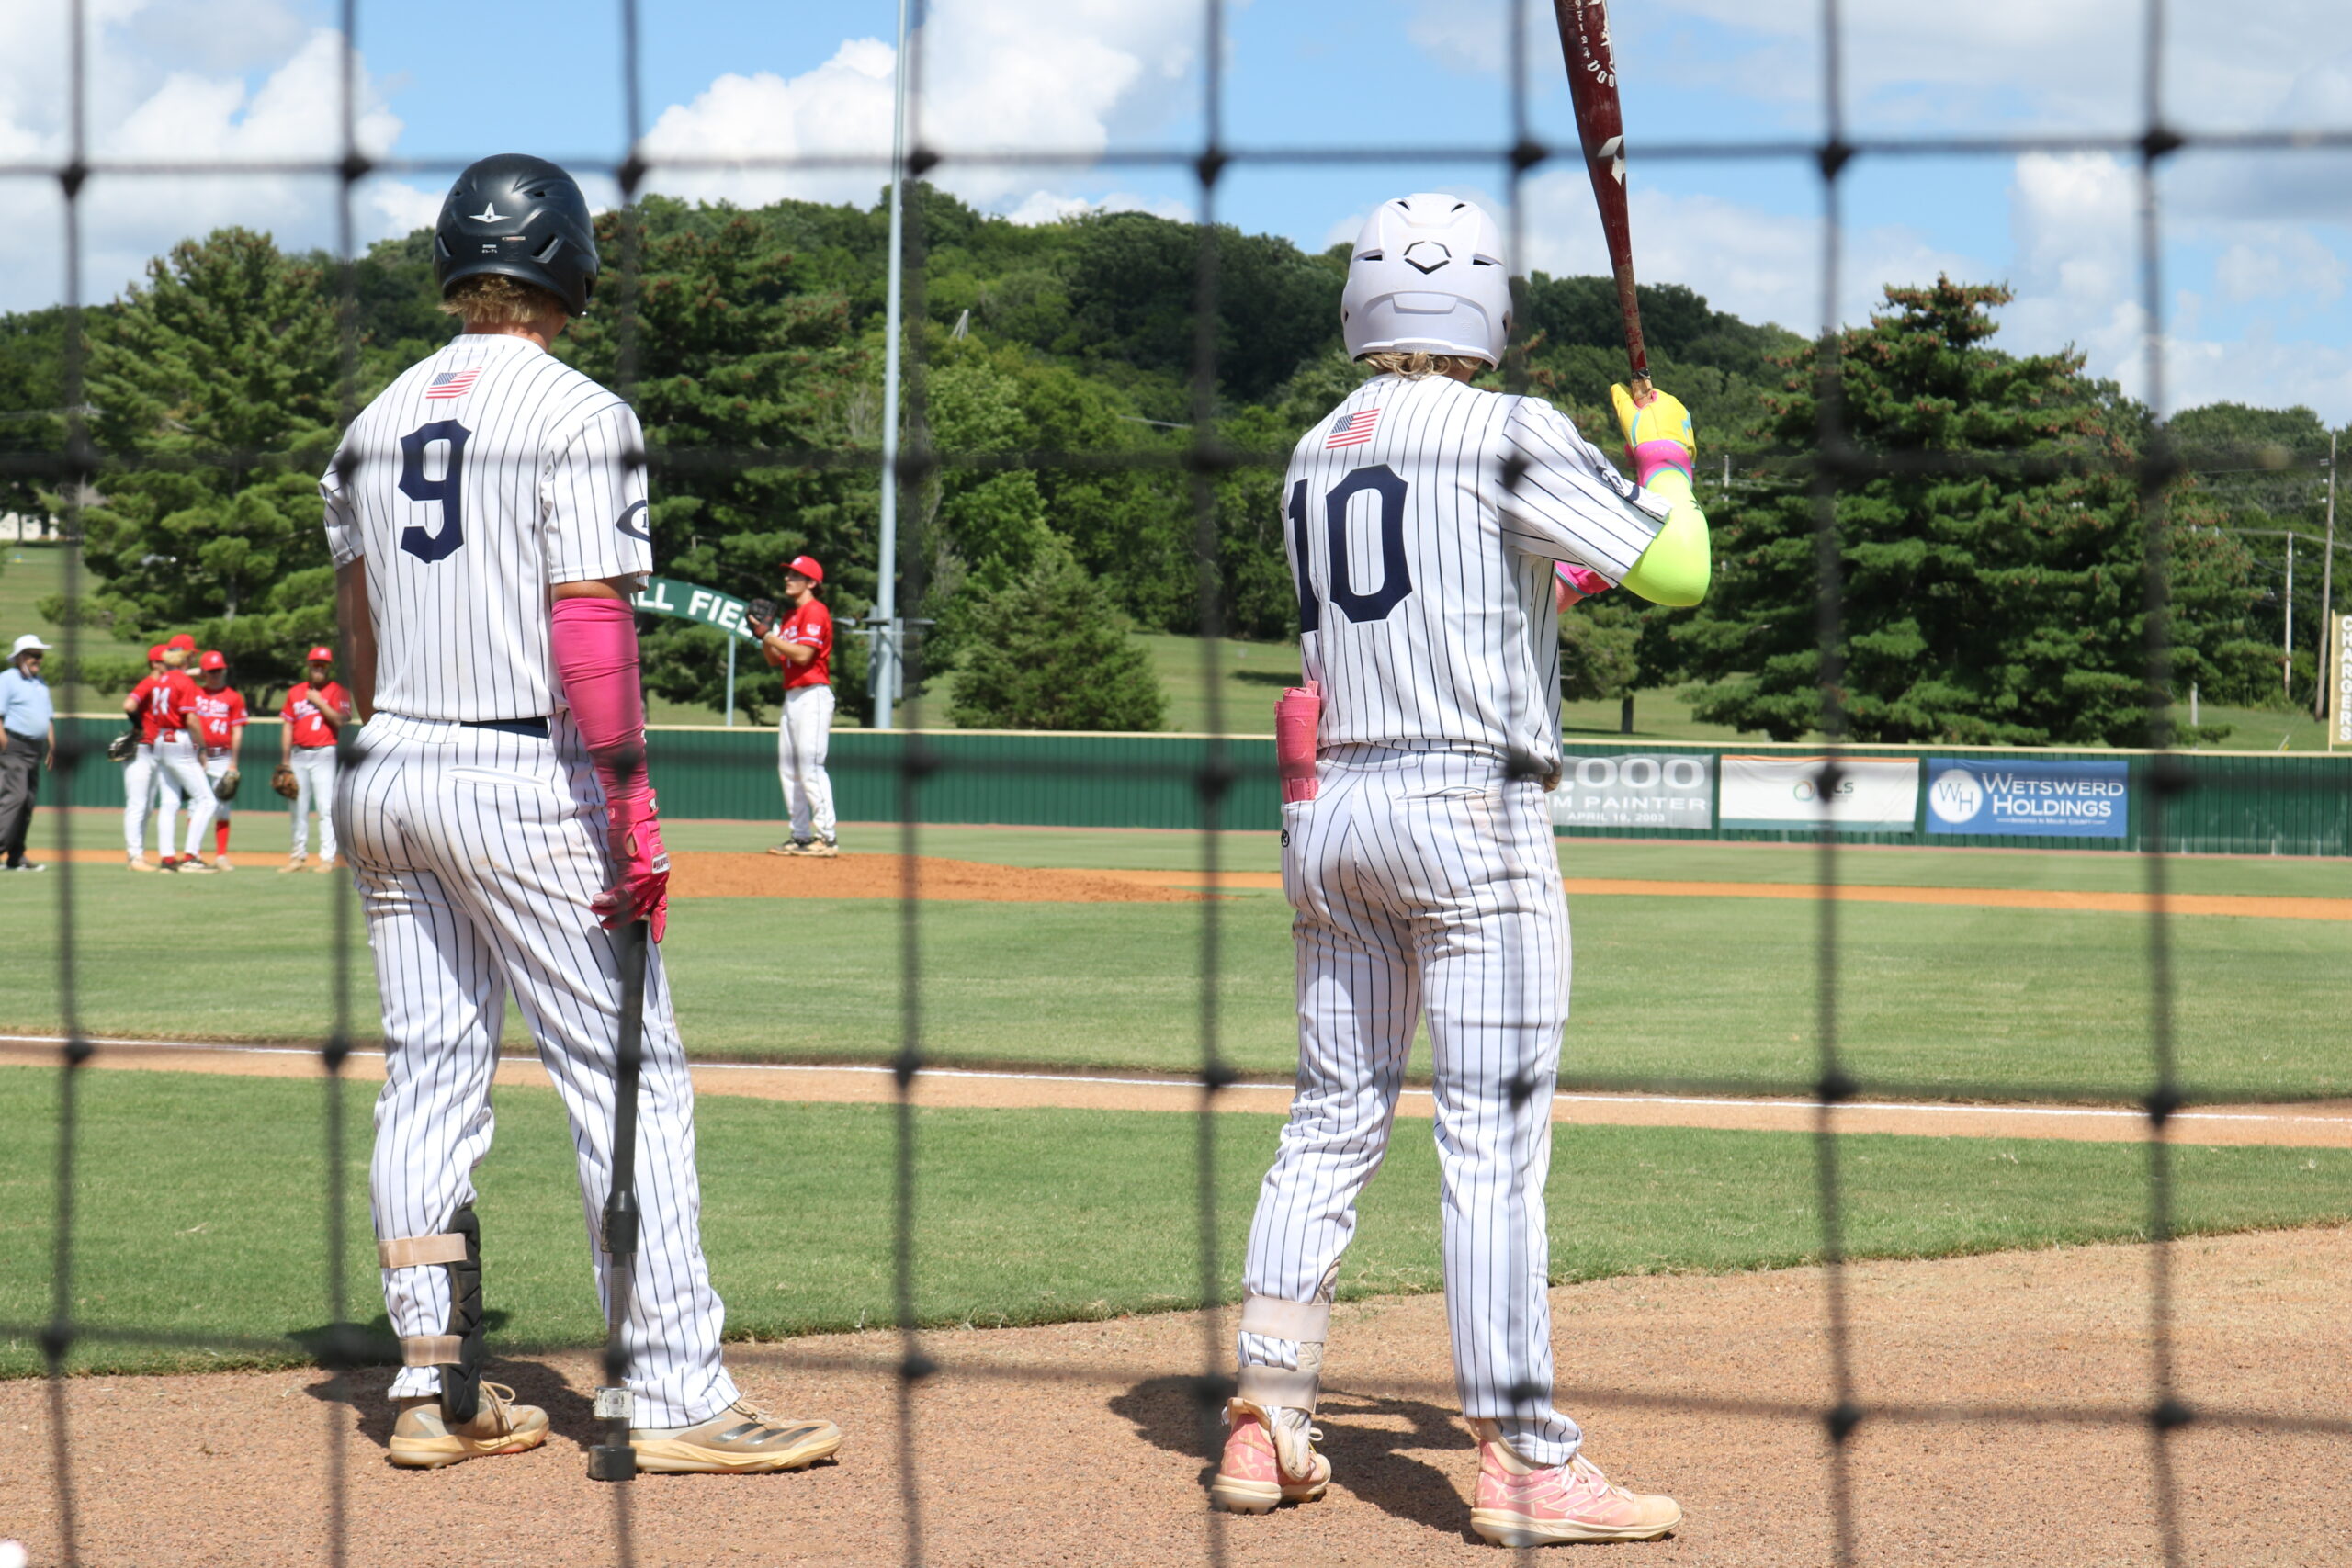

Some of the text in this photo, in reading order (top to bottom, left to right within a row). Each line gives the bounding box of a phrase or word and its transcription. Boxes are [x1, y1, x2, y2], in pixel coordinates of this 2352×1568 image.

[398, 418, 472, 564] 9
[1288, 463, 1412, 634] 10
[630, 582, 780, 640] LL FIEL
[1562, 758, 1705, 792] ,000
[1982, 773, 2124, 796] WETSWERD
[1567, 812, 1608, 821] APRIL
[1584, 796, 1706, 811] PAINTER
[1992, 795, 2112, 817] HOLDINGS
